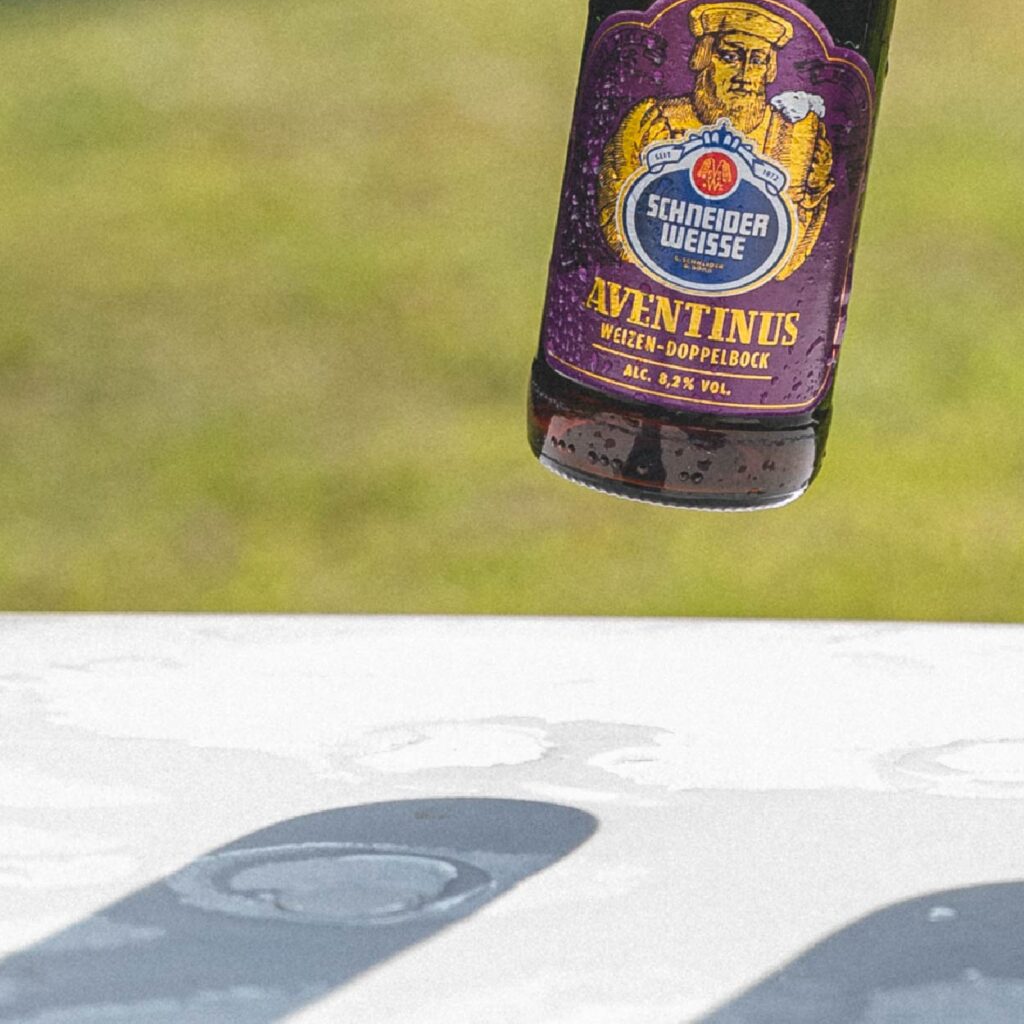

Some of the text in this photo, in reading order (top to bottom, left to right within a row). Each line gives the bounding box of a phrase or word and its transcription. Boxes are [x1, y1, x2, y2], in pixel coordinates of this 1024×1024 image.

[647, 194, 770, 237] SCHNEIDER
[661, 222, 746, 260] WEISSE
[586, 277, 800, 346] AVENTINUS
[601, 322, 770, 369] WEIZEN-DOPPELBOCK
[623, 364, 732, 396] ALC. 8,2% VOL.
